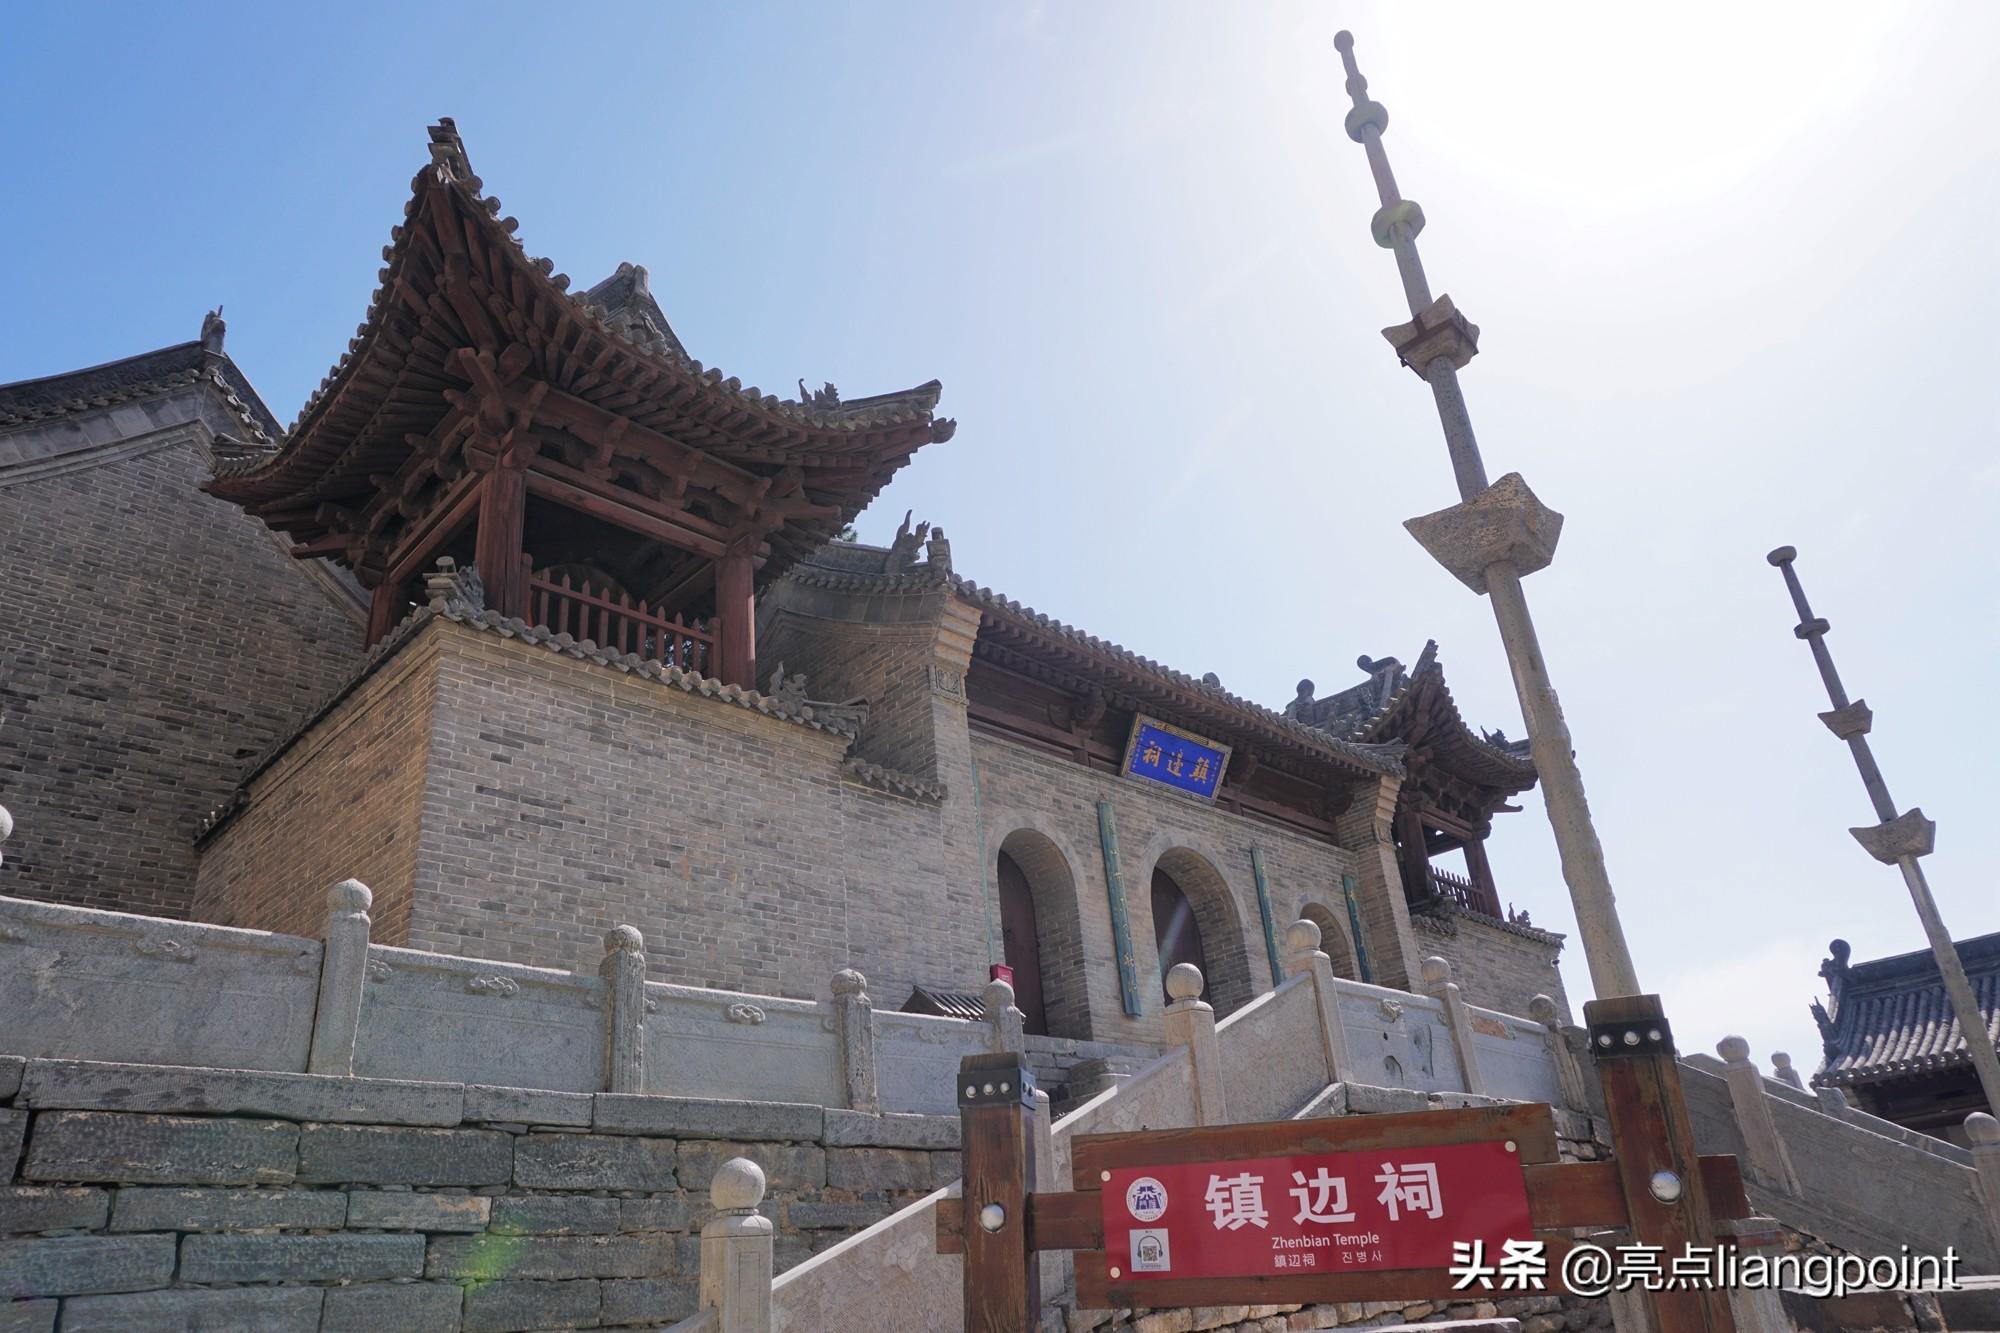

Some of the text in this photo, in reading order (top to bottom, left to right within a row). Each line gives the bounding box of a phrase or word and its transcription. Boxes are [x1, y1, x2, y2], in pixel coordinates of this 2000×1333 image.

[1204, 1161, 1444, 1230] 镇边祠
[1272, 1231, 1380, 1249] Zhenbian Temple
